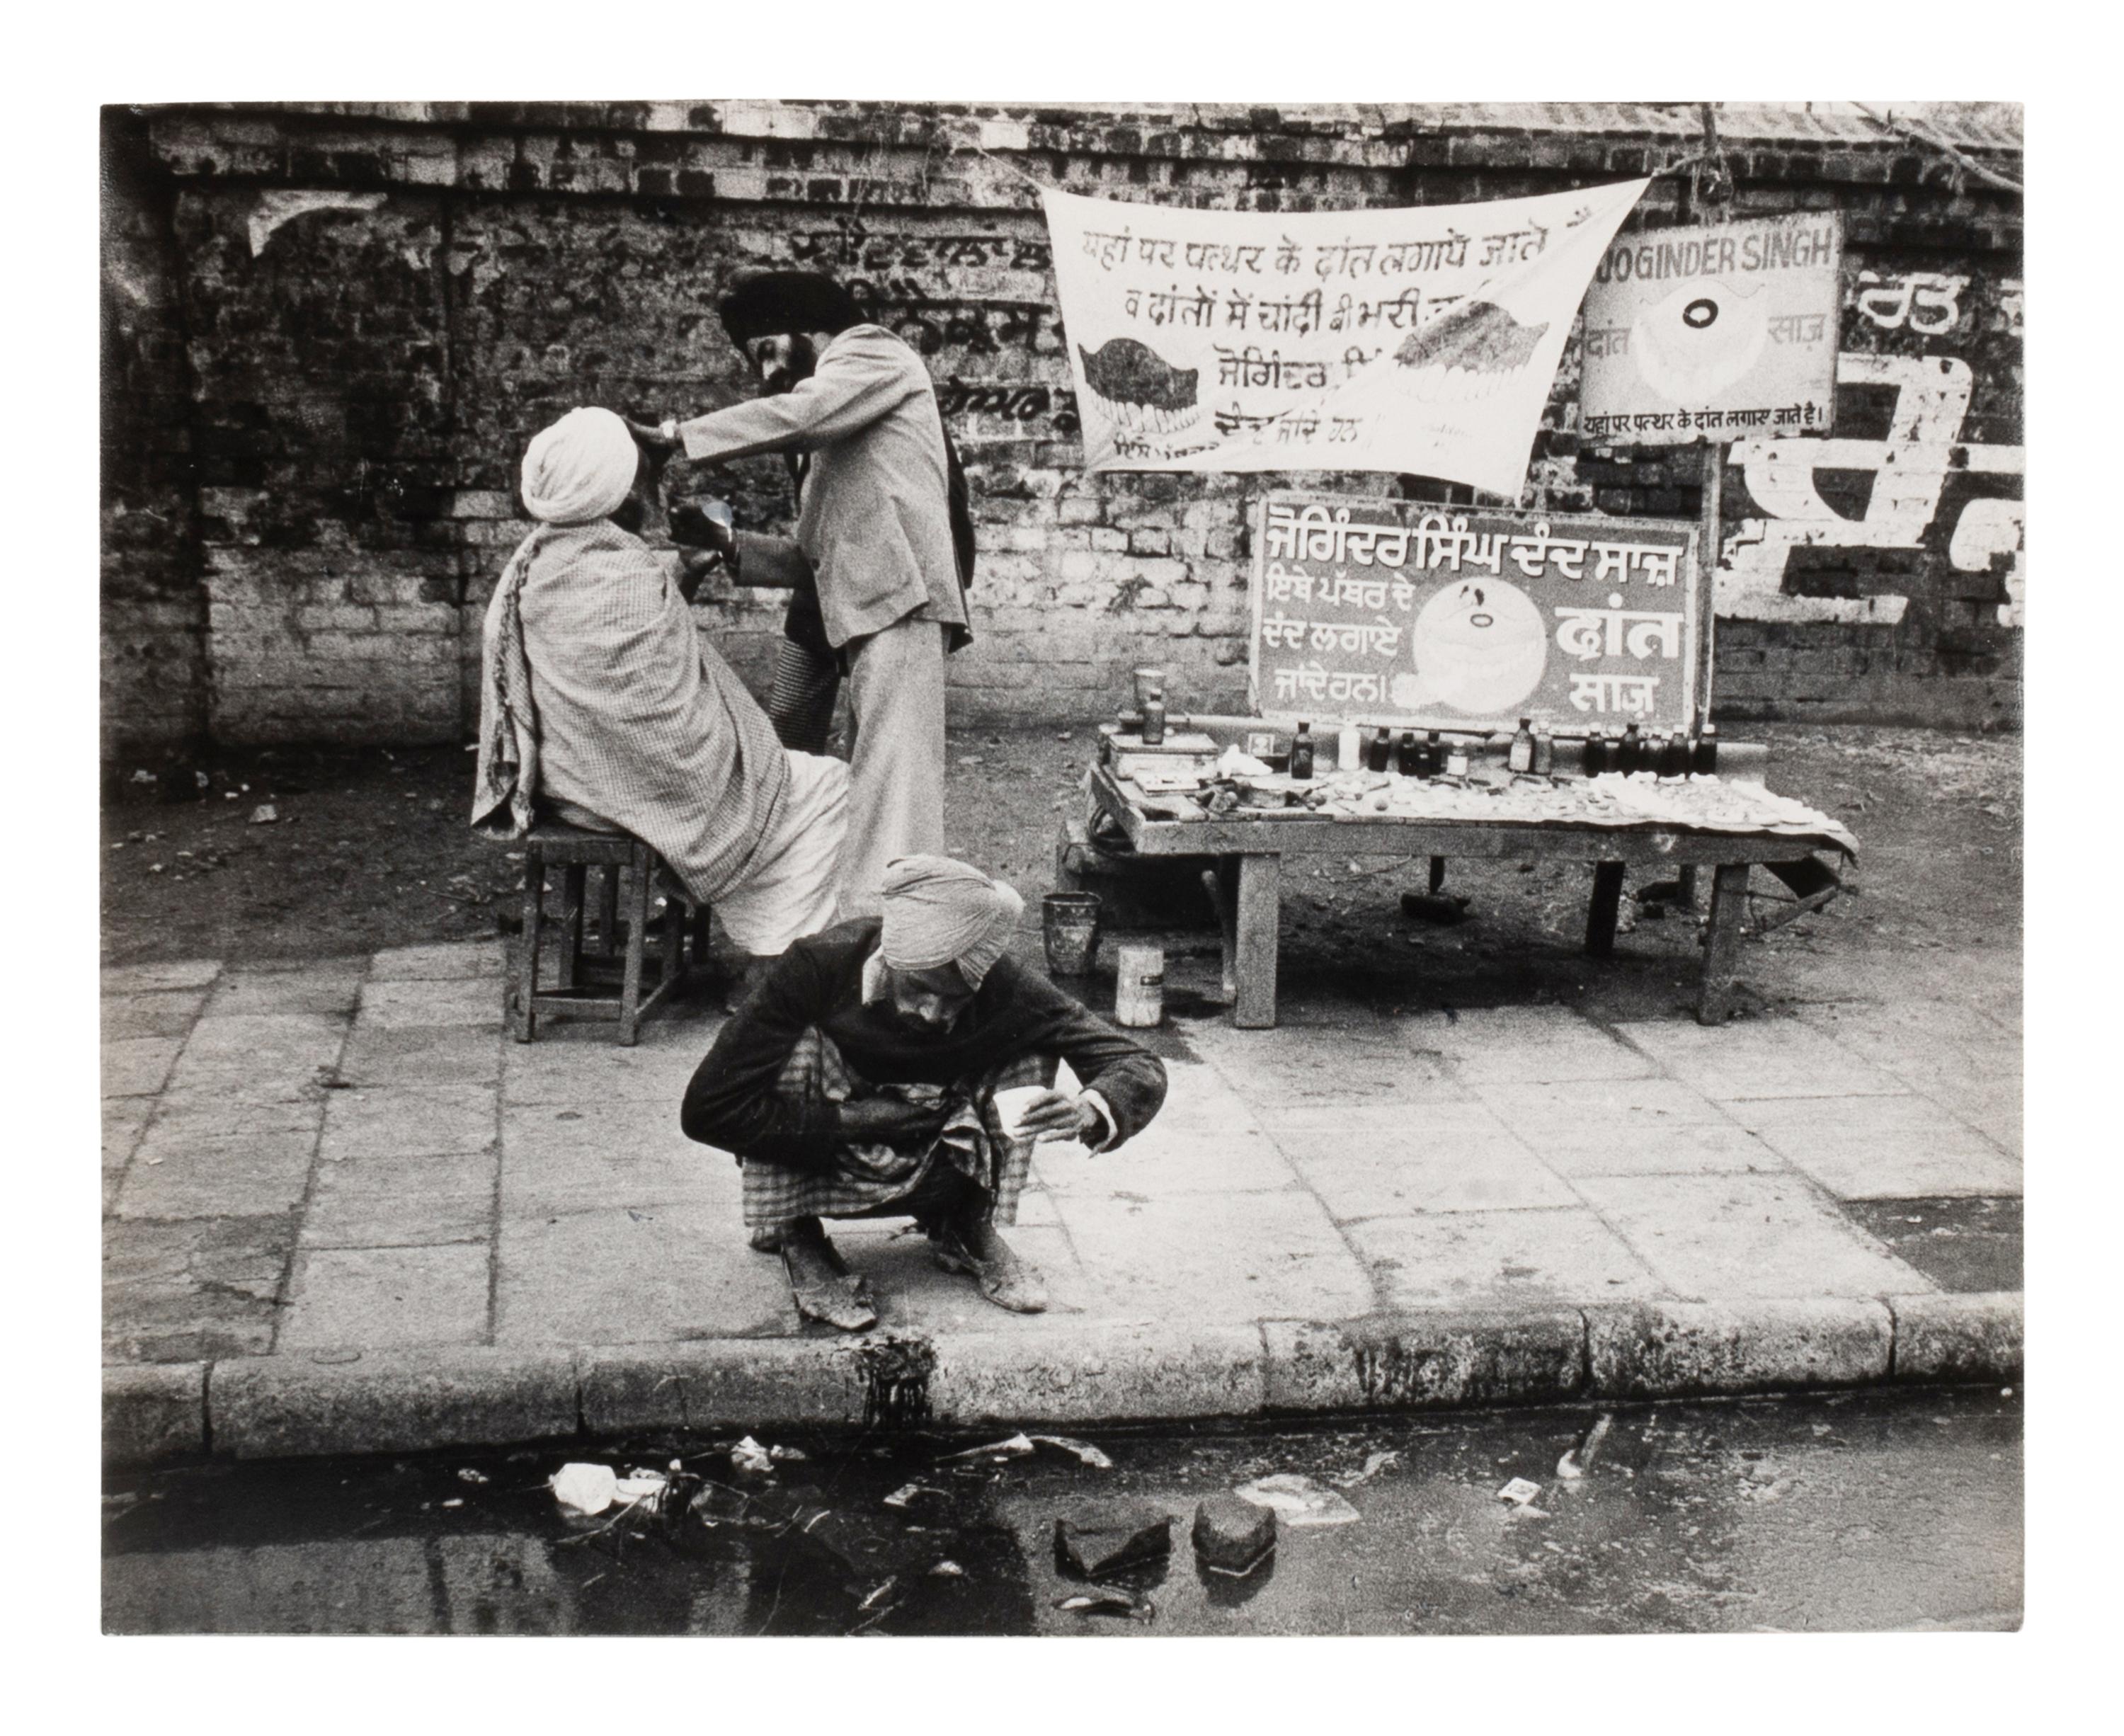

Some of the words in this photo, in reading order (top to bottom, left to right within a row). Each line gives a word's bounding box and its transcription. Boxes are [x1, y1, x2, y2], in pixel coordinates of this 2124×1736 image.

[1083, 225, 1132, 271] यहां
[1139, 237, 1176, 269] पर
[1275, 234, 1302, 275] के
[1315, 236, 1377, 282] दांत
[1596, 236, 1735, 285] JOGINDER
[1741, 227, 1832, 271] SINGH
[1613, 415, 1631, 433] पर
[1677, 409, 1692, 428] के
[1694, 406, 1724, 430] दांत
[1412, 515, 1509, 575] ਸਿੰਘ
[1510, 521, 1590, 581] ਦੰਦ
[1262, 610, 1308, 649] ਦੰਦ
[1555, 592, 1684, 661] दांत
